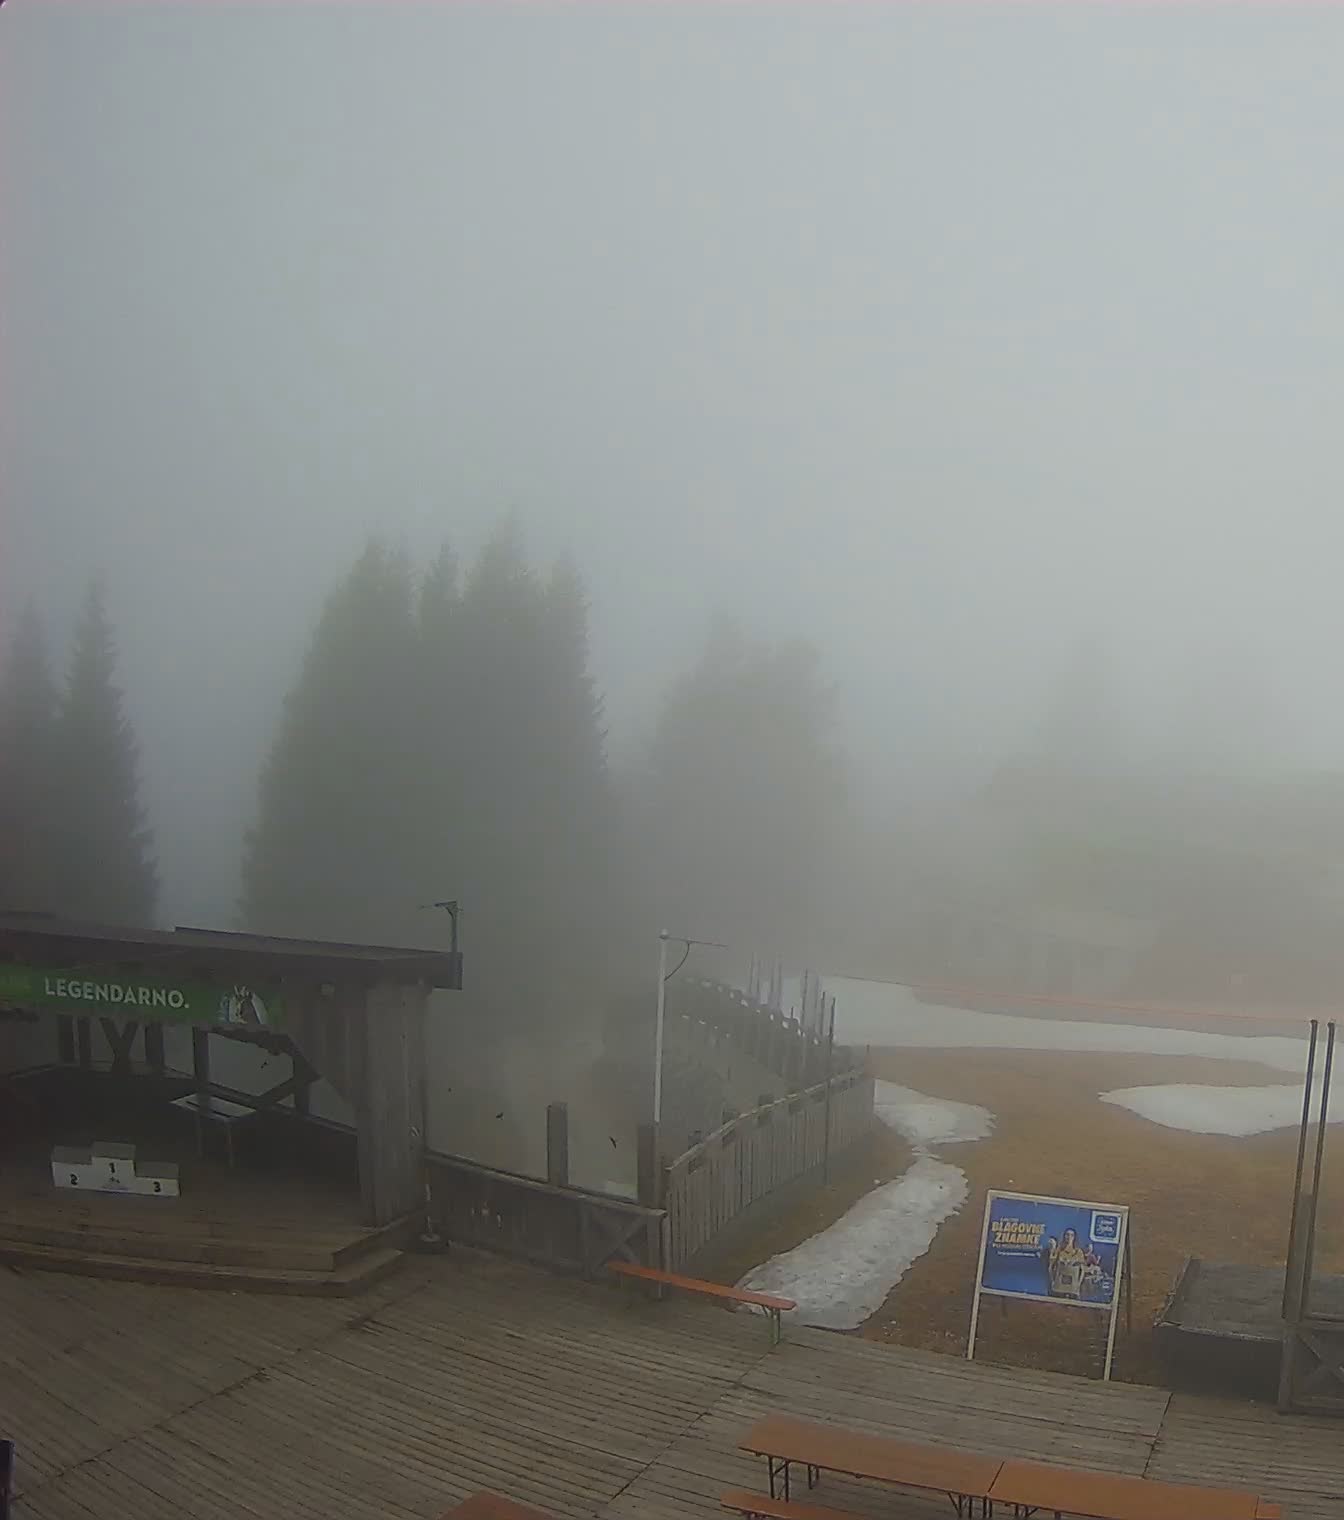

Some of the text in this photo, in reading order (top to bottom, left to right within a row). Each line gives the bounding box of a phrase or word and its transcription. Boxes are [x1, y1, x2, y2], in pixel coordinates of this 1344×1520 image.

[44, 977, 190, 1009] LEGENDARNO.
[108, 1162, 117, 1174] 1
[69, 1173, 79, 1186] 2
[153, 1181, 162, 1193] 3
